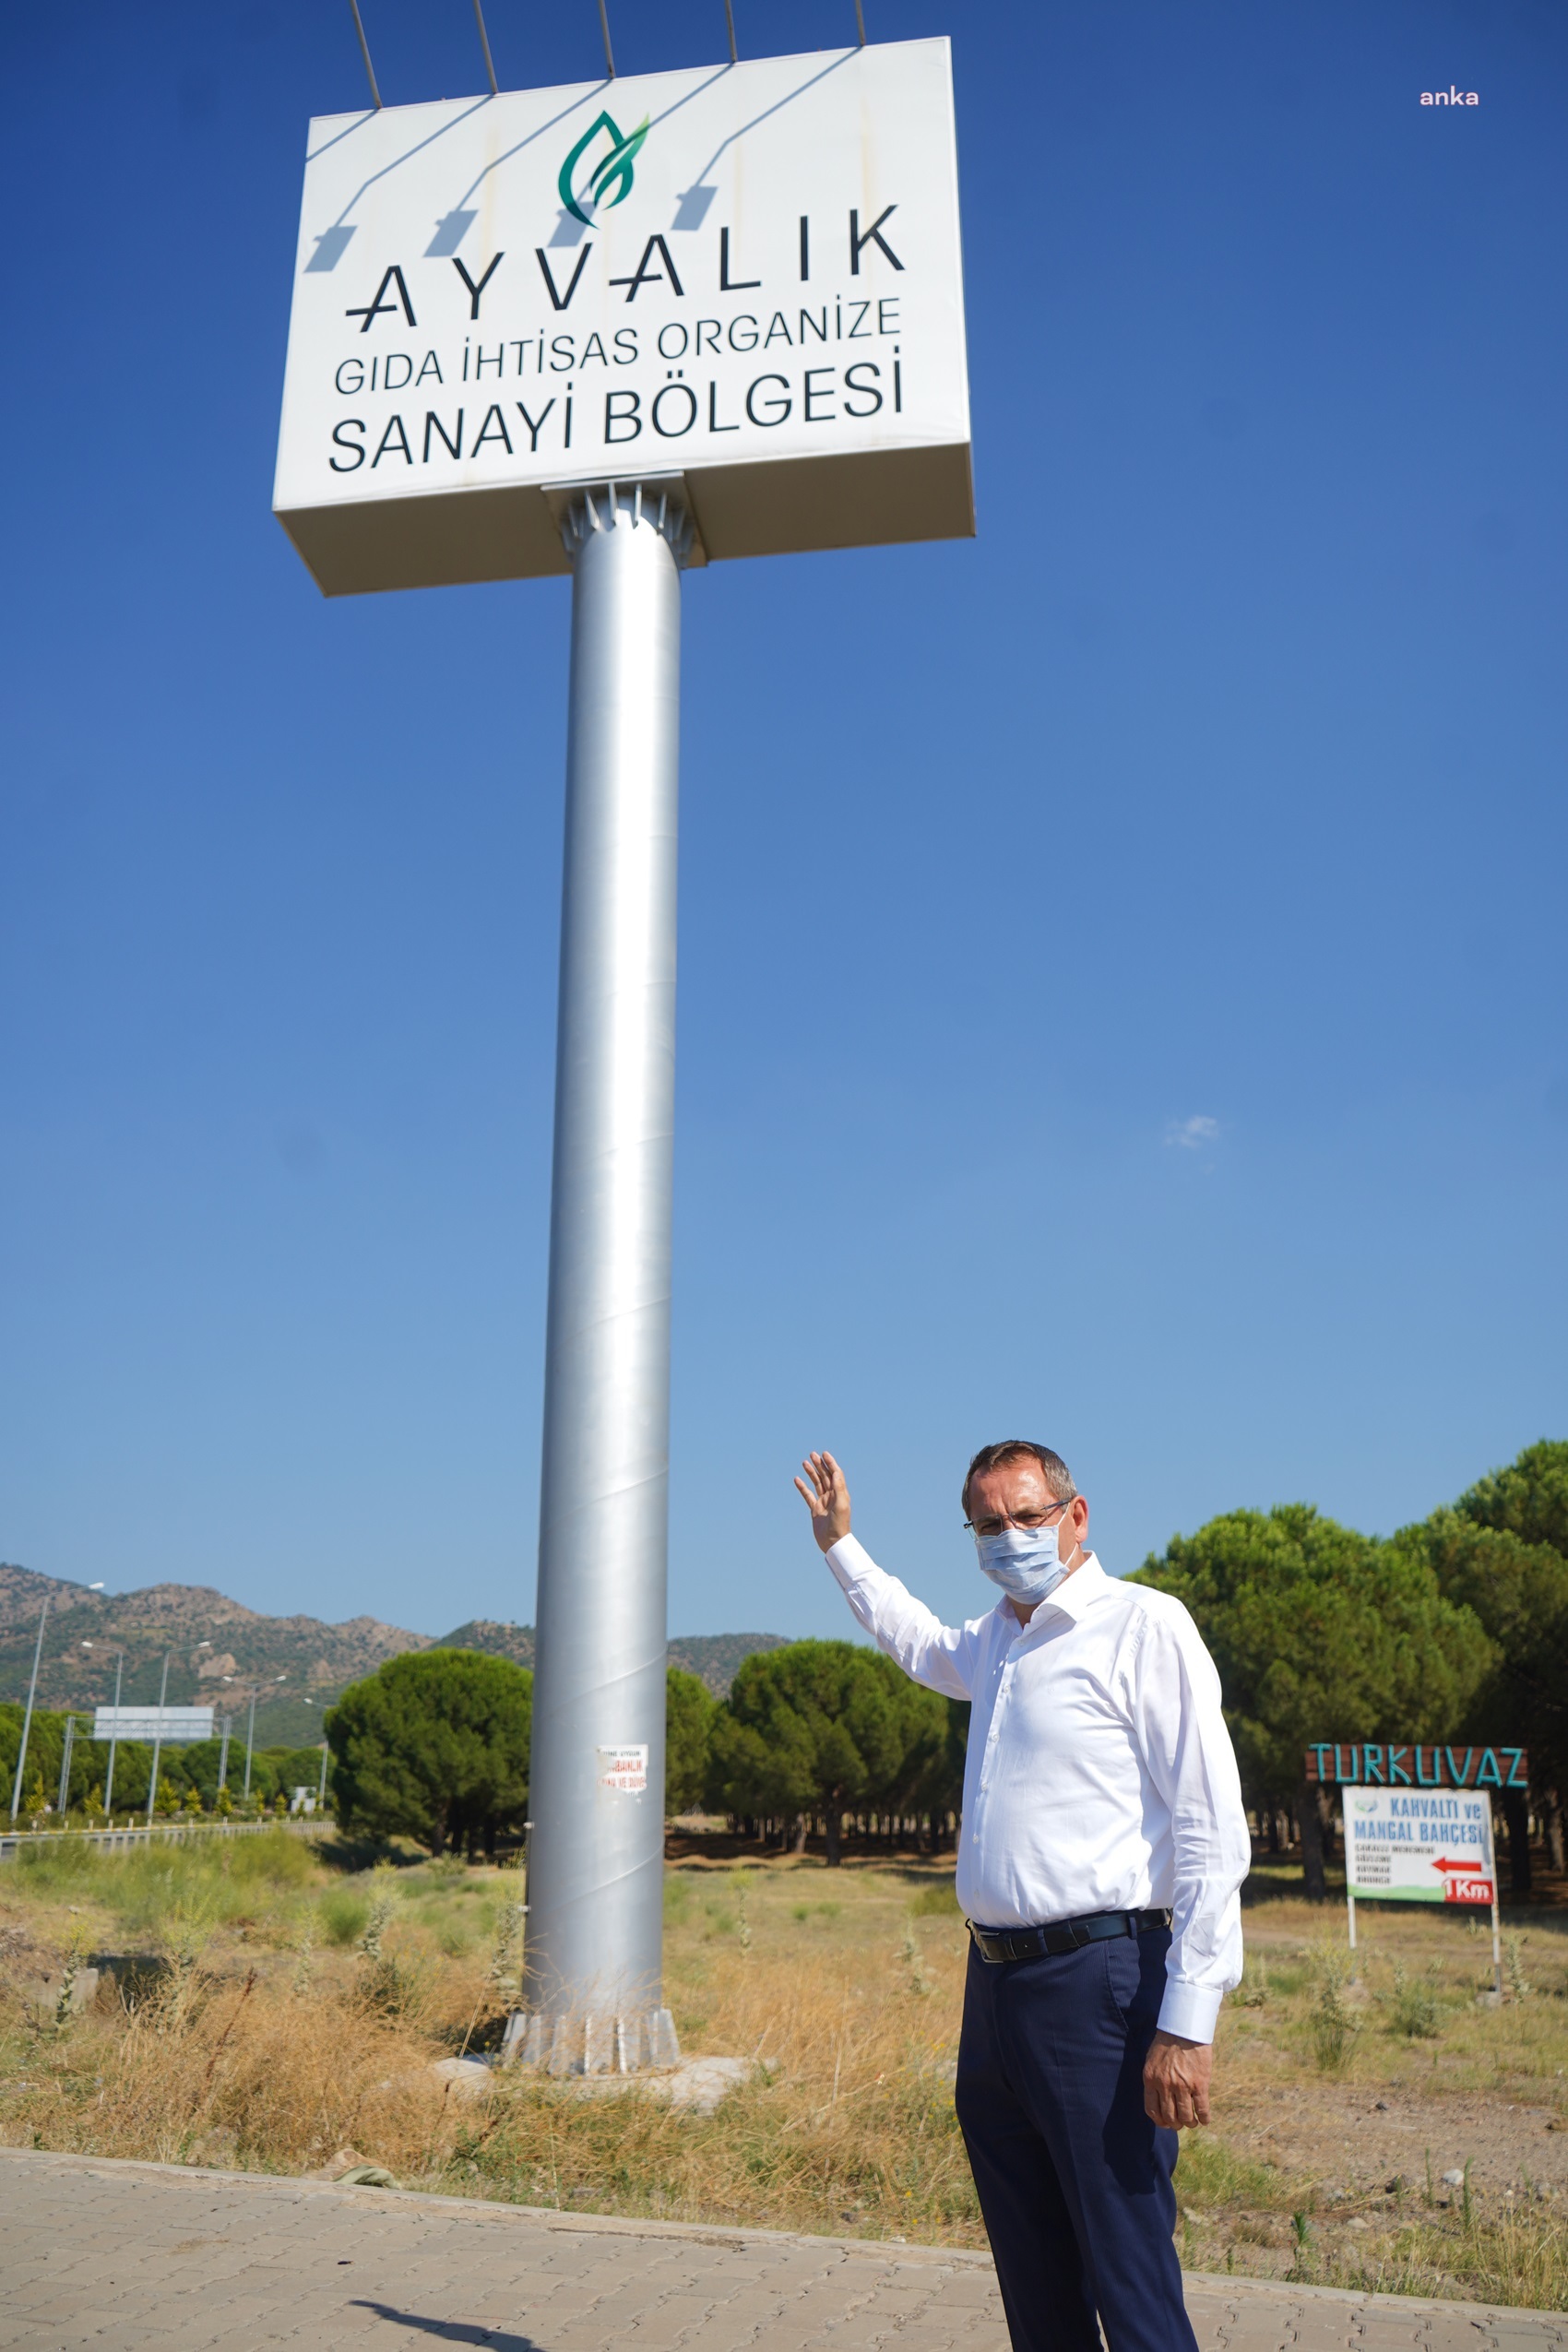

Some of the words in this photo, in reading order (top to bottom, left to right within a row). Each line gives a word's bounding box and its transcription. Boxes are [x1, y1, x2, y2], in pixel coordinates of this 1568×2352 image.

[345, 204, 906, 333] AYVALIK
[334, 350, 445, 395] GIDA
[462, 327, 639, 382] İHTİSAS
[657, 293, 901, 360] ORGANİZE
[328, 381, 573, 472] SANAYİ
[604, 346, 902, 445] BÖLGESİ
[1308, 1742, 1528, 1788] TURKUVAZ
[1354, 1820, 1414, 1841] MANGAL
[1419, 1823, 1484, 1846] BAHÇESİ
[1390, 1798, 1458, 1819] KAHVALTI
